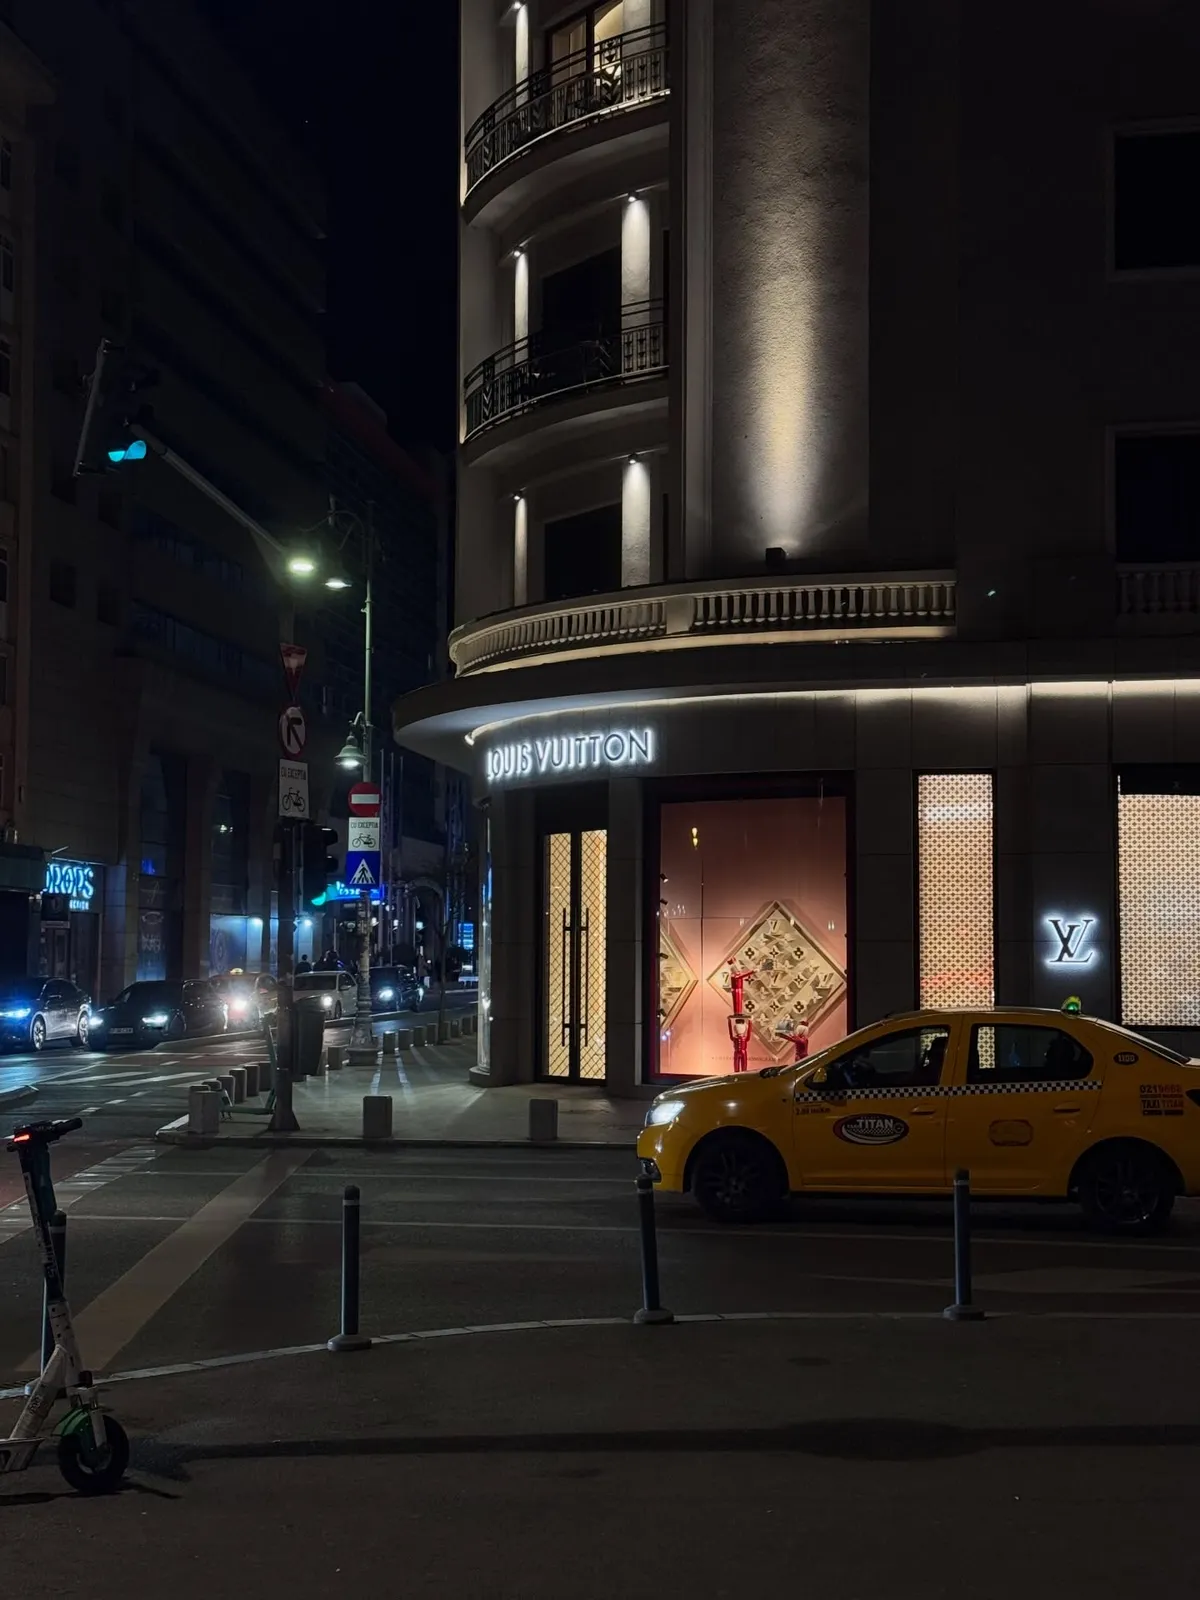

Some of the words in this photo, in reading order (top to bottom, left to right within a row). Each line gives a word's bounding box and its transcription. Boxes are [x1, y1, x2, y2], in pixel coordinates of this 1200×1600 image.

[536, 730, 651, 771] VUITTON
[1141, 1099, 1160, 1109] TAXI
[856, 1119, 894, 1129] TITAN
